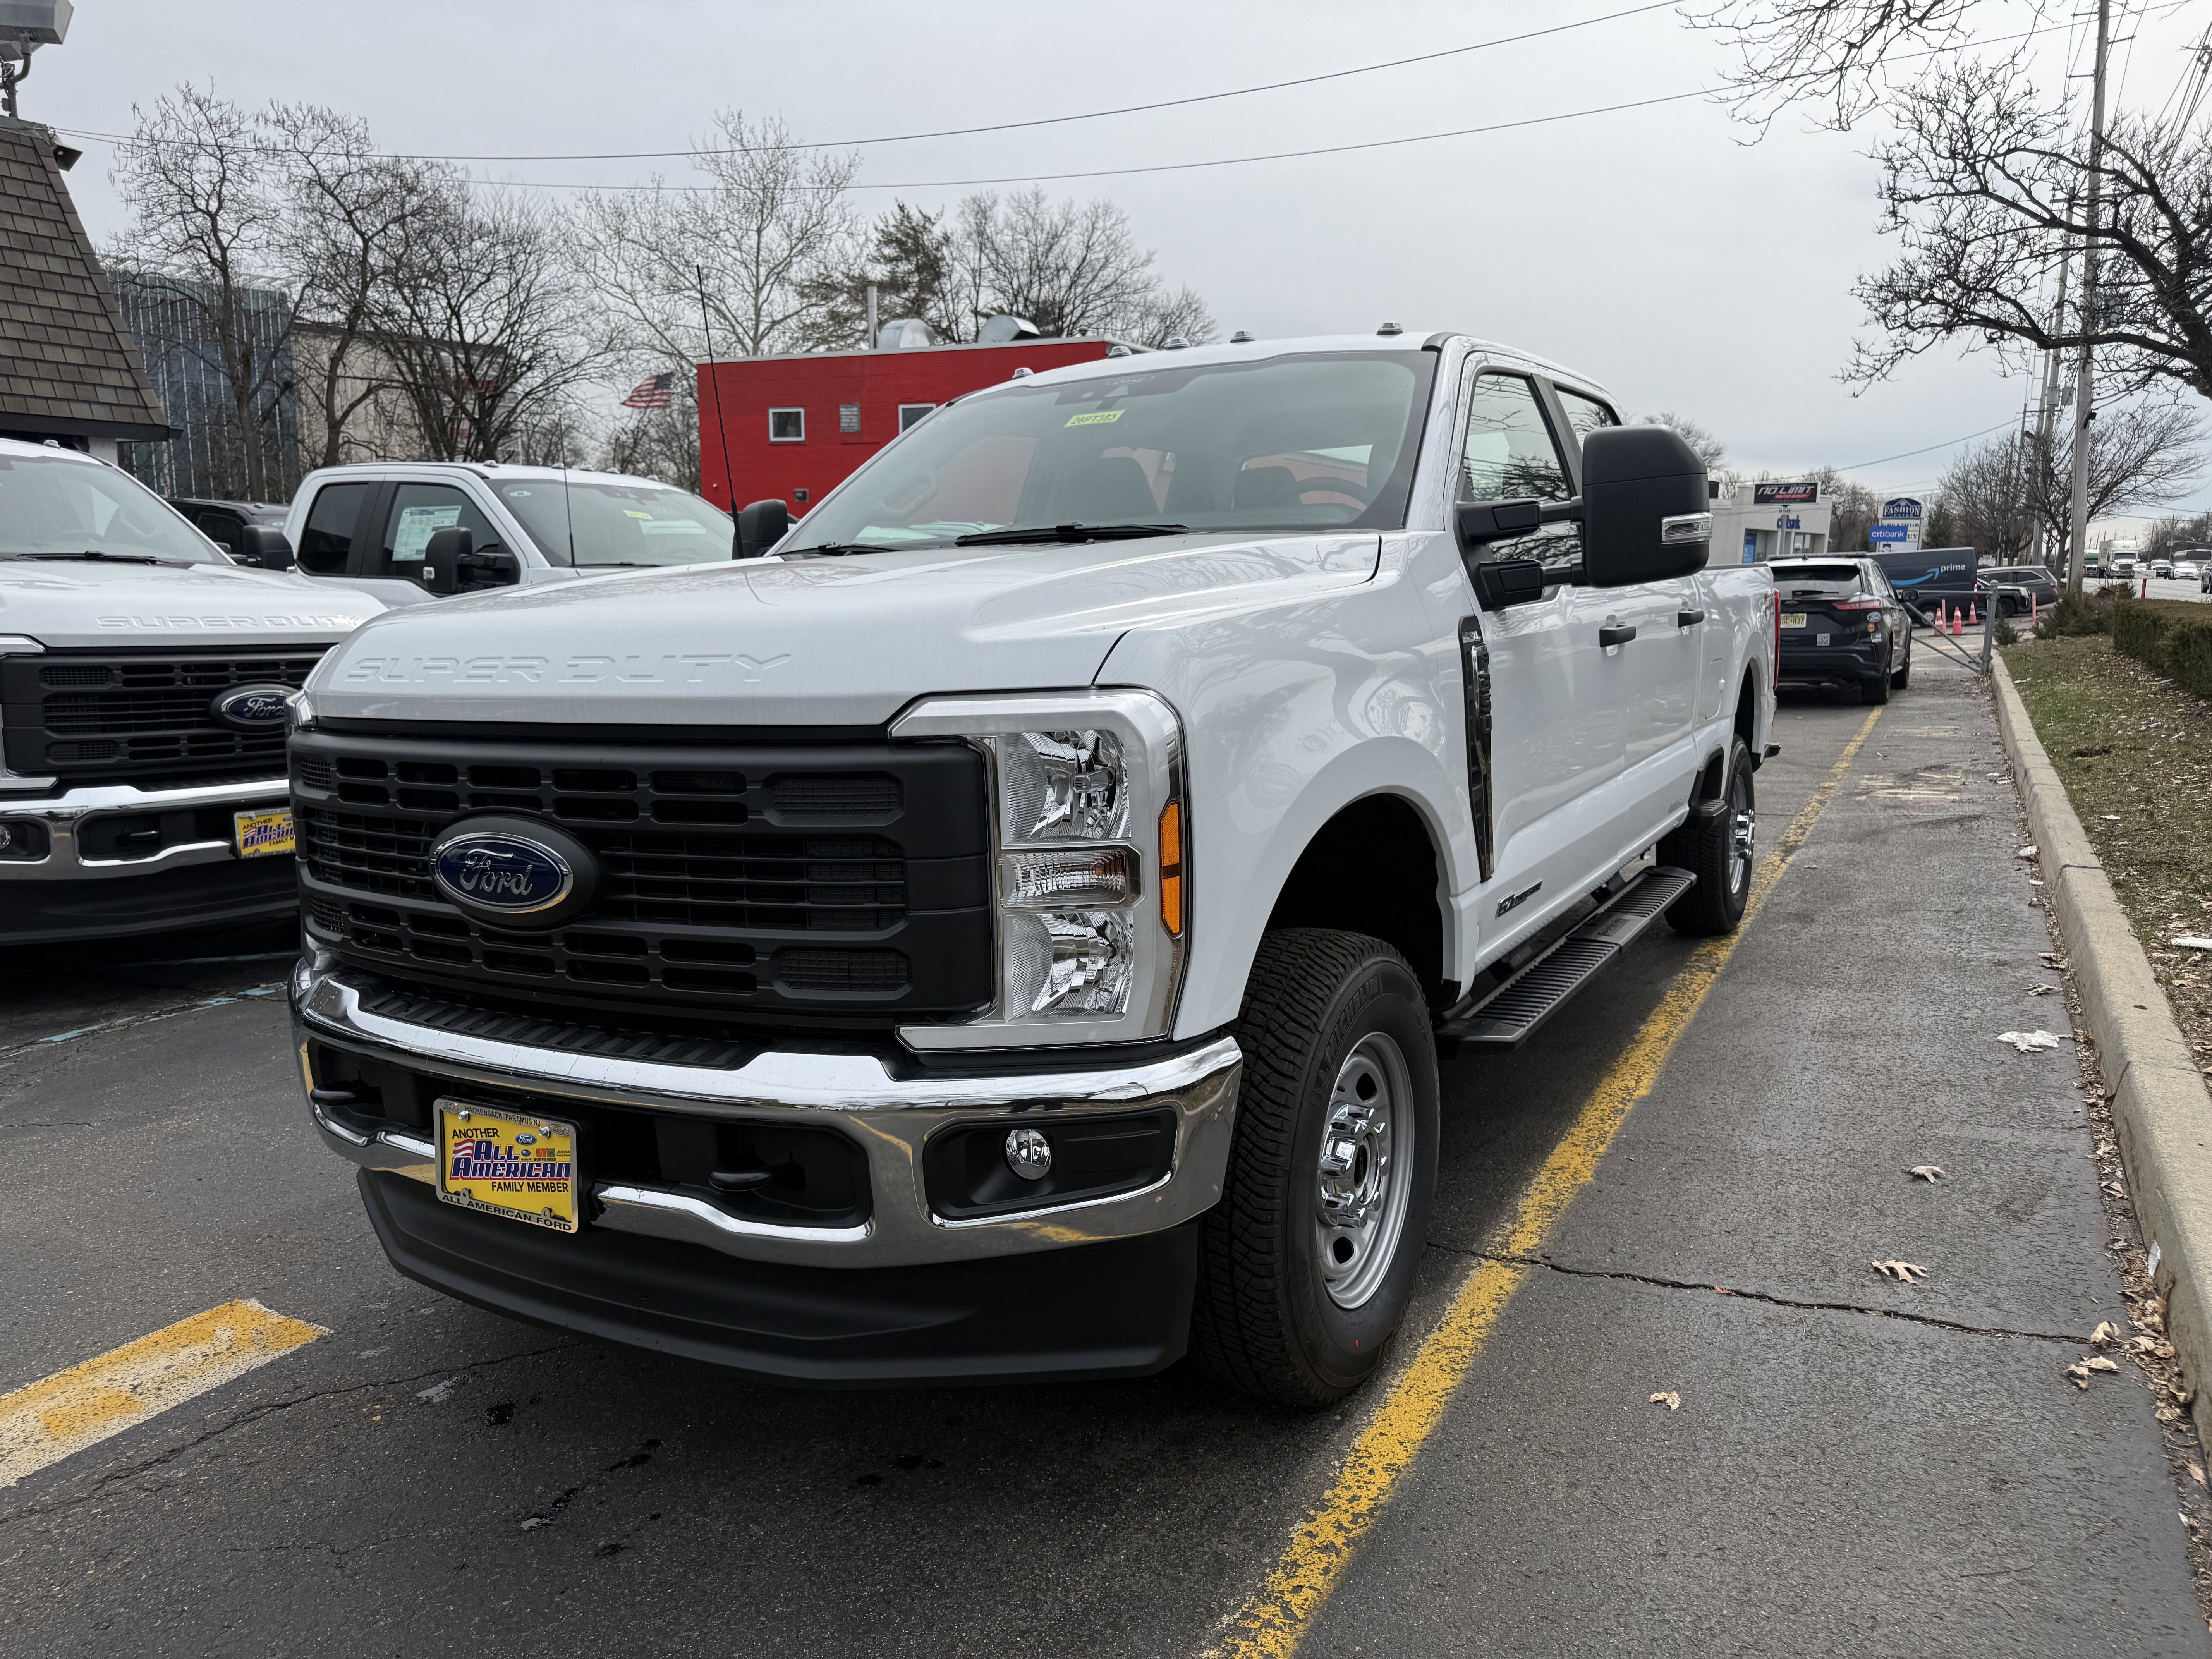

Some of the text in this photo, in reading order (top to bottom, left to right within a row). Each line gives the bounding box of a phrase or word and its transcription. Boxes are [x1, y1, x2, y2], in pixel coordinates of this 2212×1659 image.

[1070, 414, 1117, 425] 26PT383
[1779, 485, 1815, 494] LIMIT
[1884, 507, 1920, 516] FASHION
[1872, 530, 1904, 538] citibank
[1941, 563, 1965, 573] prime
[97, 614, 359, 629] SUPER DUTY
[345, 653, 792, 682] SUPER DUTY
[243, 818, 273, 830] ANOTHER
[269, 838, 288, 846] FAMILY
[460, 848, 533, 895] Ford
[1325, 975, 1379, 1064] MICHELIN
[465, 1106, 541, 1127] HACKENSACK PARAMUS NJ
[452, 1128, 500, 1139] ANOTHER
[472, 1139, 520, 1161] ALL
[450, 1156, 571, 1180] AMERICAN
[491, 1182, 569, 1192] FAMILY MEMBER
[442, 1195, 571, 1231] ALL AMERICAN FORD
